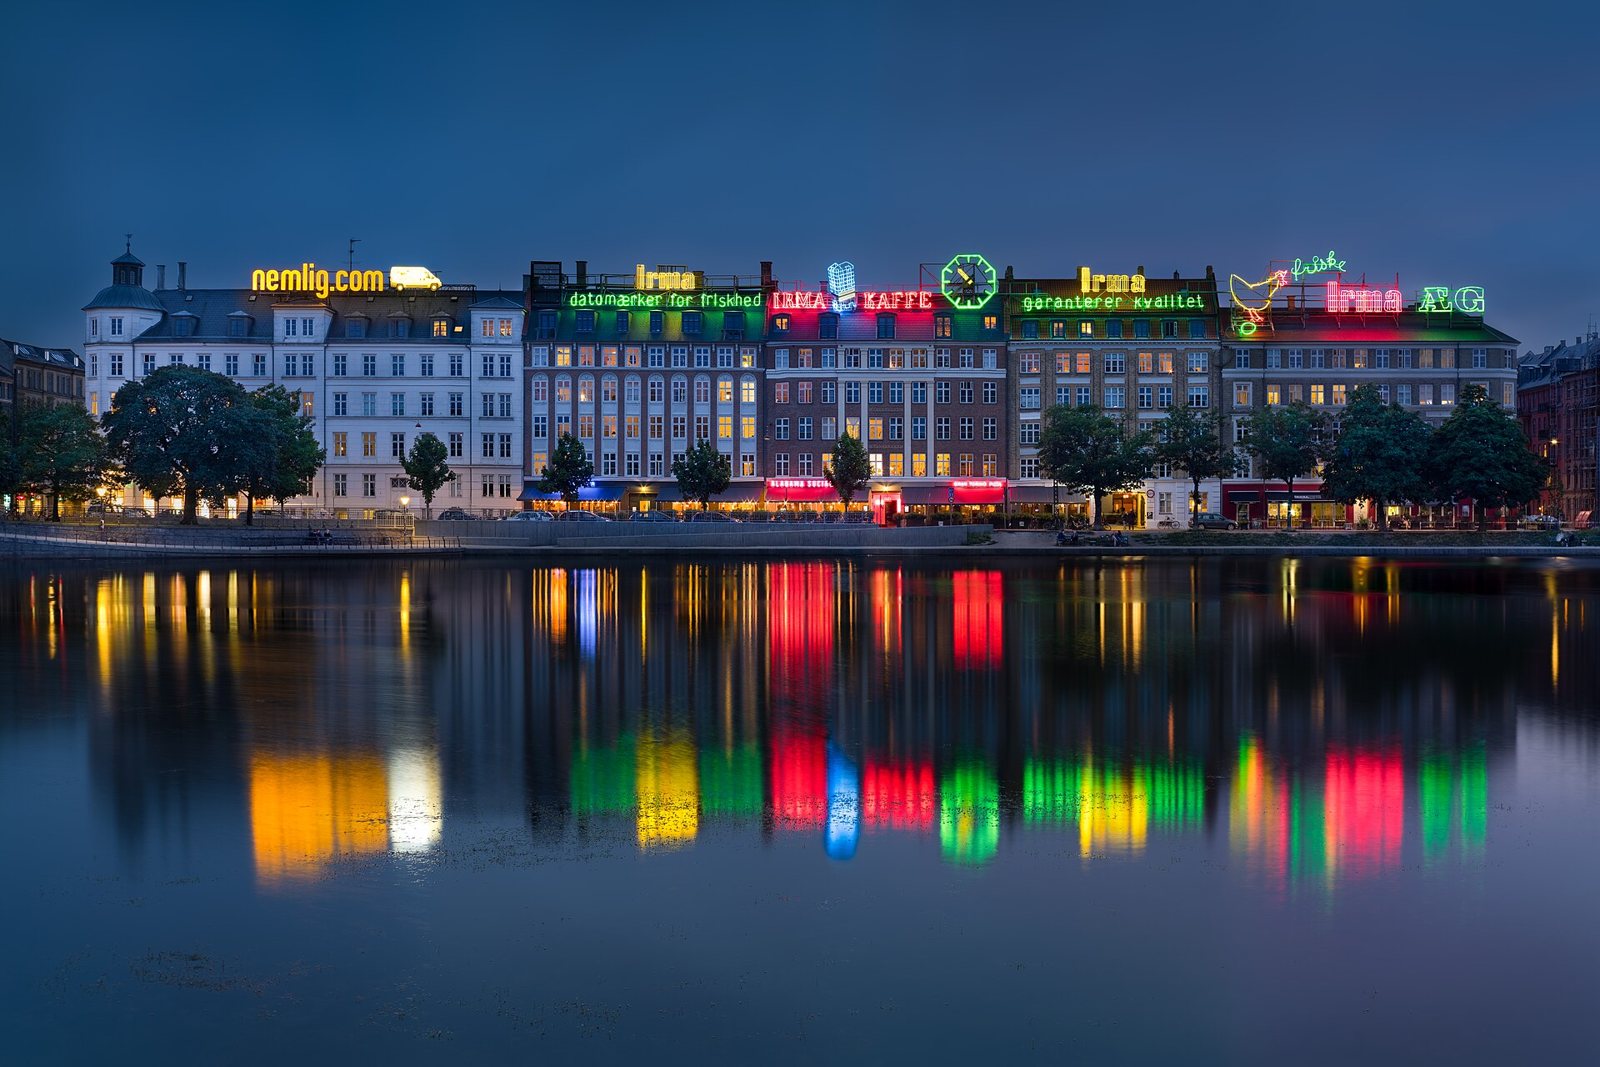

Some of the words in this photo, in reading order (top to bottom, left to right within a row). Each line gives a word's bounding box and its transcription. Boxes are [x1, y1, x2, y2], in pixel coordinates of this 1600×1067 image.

[636, 263, 696, 290] Irma
[1291, 250, 1347, 281] friske
[252, 262, 384, 298] nemlig.com
[1081, 266, 1146, 293] Irma
[670, 292, 693, 307] for
[701, 292, 761, 307] friskhed
[772, 291, 827, 309] IRMA
[863, 291, 932, 309] KAFFE
[1023, 295, 1123, 312] garanterer
[1134, 294, 1205, 309] kvalitet
[1327, 281, 1402, 312] Irma
[1419, 286, 1485, 312] ÆG
